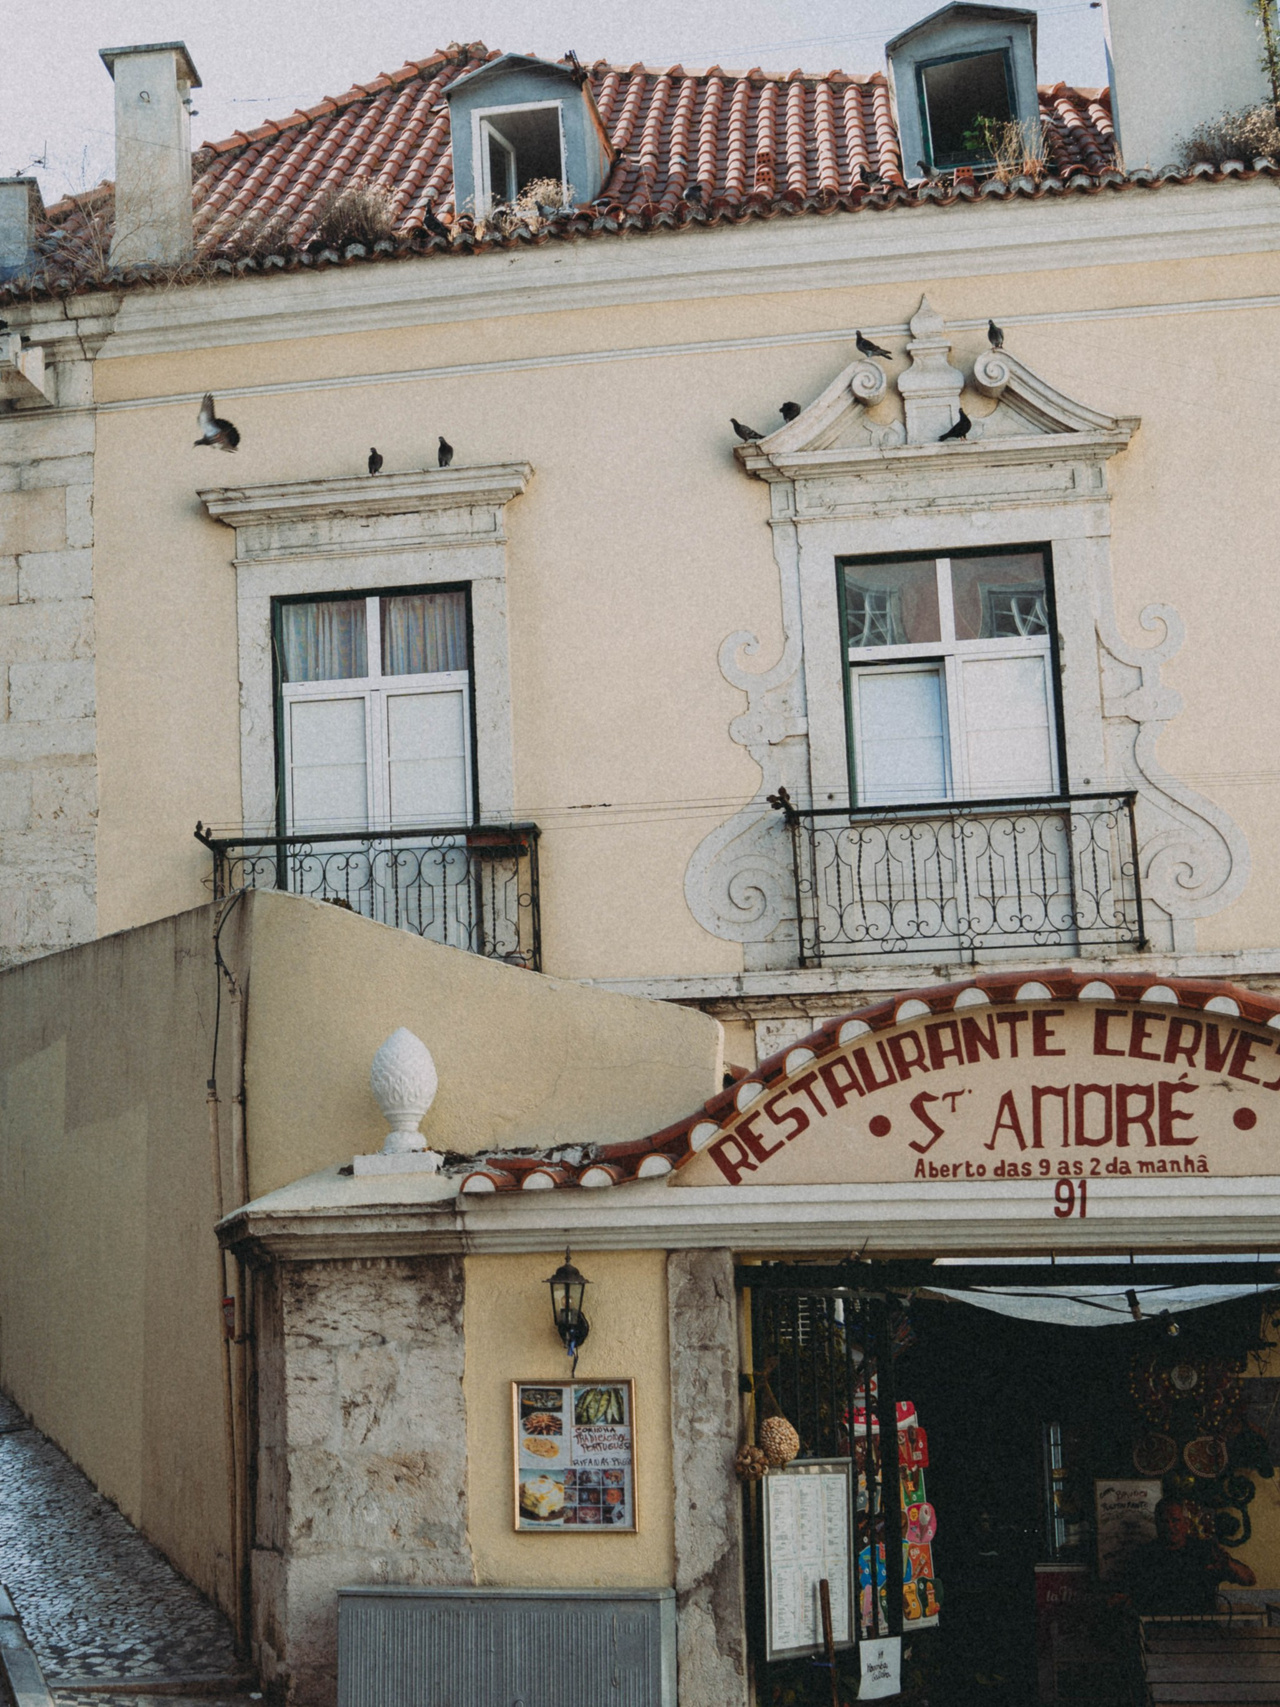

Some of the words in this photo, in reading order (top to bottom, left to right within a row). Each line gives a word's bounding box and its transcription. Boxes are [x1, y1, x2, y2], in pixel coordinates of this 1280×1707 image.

[707, 1009, 1066, 1186] RESTAURANTE
[984, 1072, 1199, 1151] ANDRÉ
[914, 1158, 987, 1179] Aberto
[993, 1159, 1033, 1178] das
[1038, 1158, 1051, 1177] 9
[1056, 1160, 1084, 1176] as
[1089, 1158, 1102, 1177] 2
[1105, 1157, 1133, 1175] da
[1053, 1179, 1088, 1219] 91
